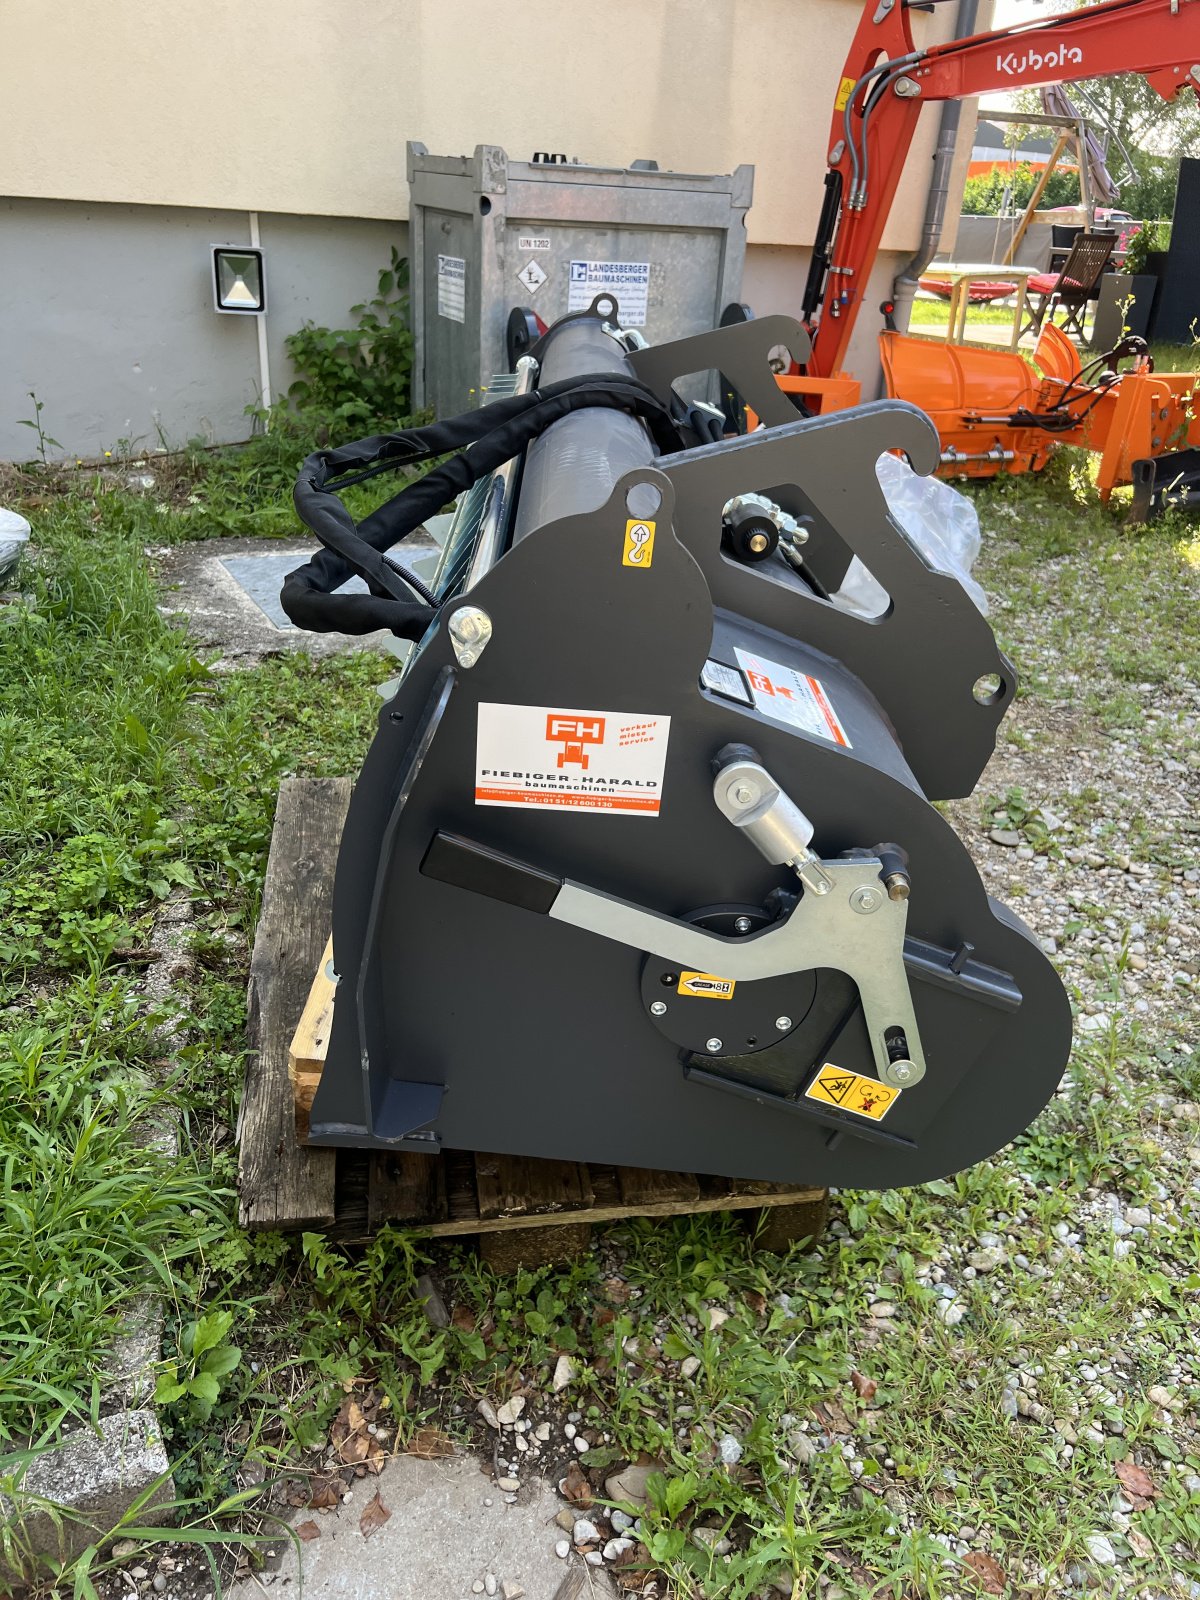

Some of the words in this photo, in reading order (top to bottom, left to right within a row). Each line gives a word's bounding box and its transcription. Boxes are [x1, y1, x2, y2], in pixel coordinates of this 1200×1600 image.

[996, 43, 1083, 75] Kubota
[520, 239, 531, 248] UN
[588, 263, 648, 274] LANDESBERGER
[588, 275, 648, 284] BAUMASCHINEN
[551, 720, 600, 739] FH
[620, 722, 657, 733] verkauf
[618, 737, 654, 747] service
[525, 781, 615, 793] baumaschinen
